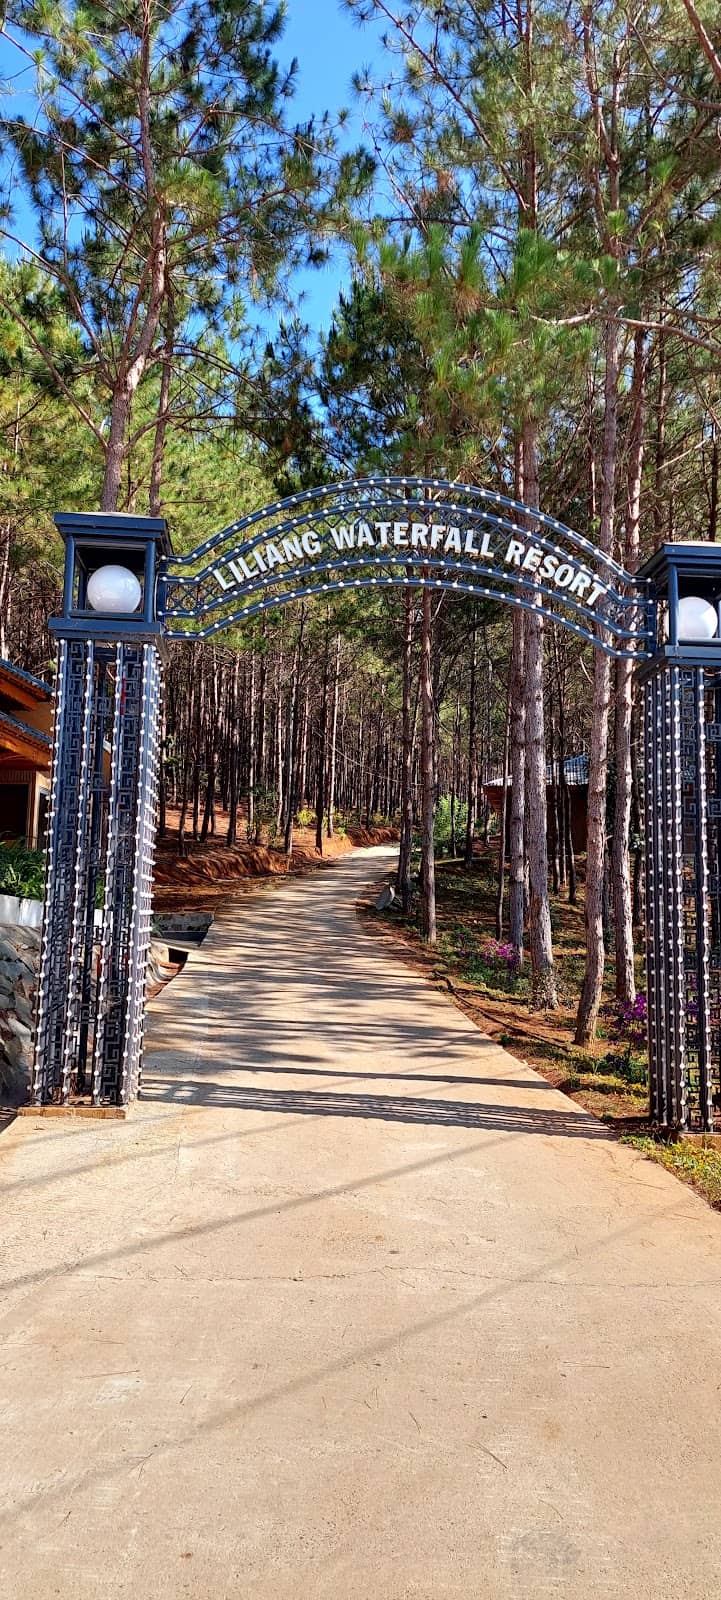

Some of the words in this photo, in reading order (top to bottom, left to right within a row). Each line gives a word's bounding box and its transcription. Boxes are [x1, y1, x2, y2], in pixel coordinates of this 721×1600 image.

[212, 532, 322, 592] LILIANG
[330, 521, 495, 558] WATERFALL
[504, 540, 608, 606] RESORT
